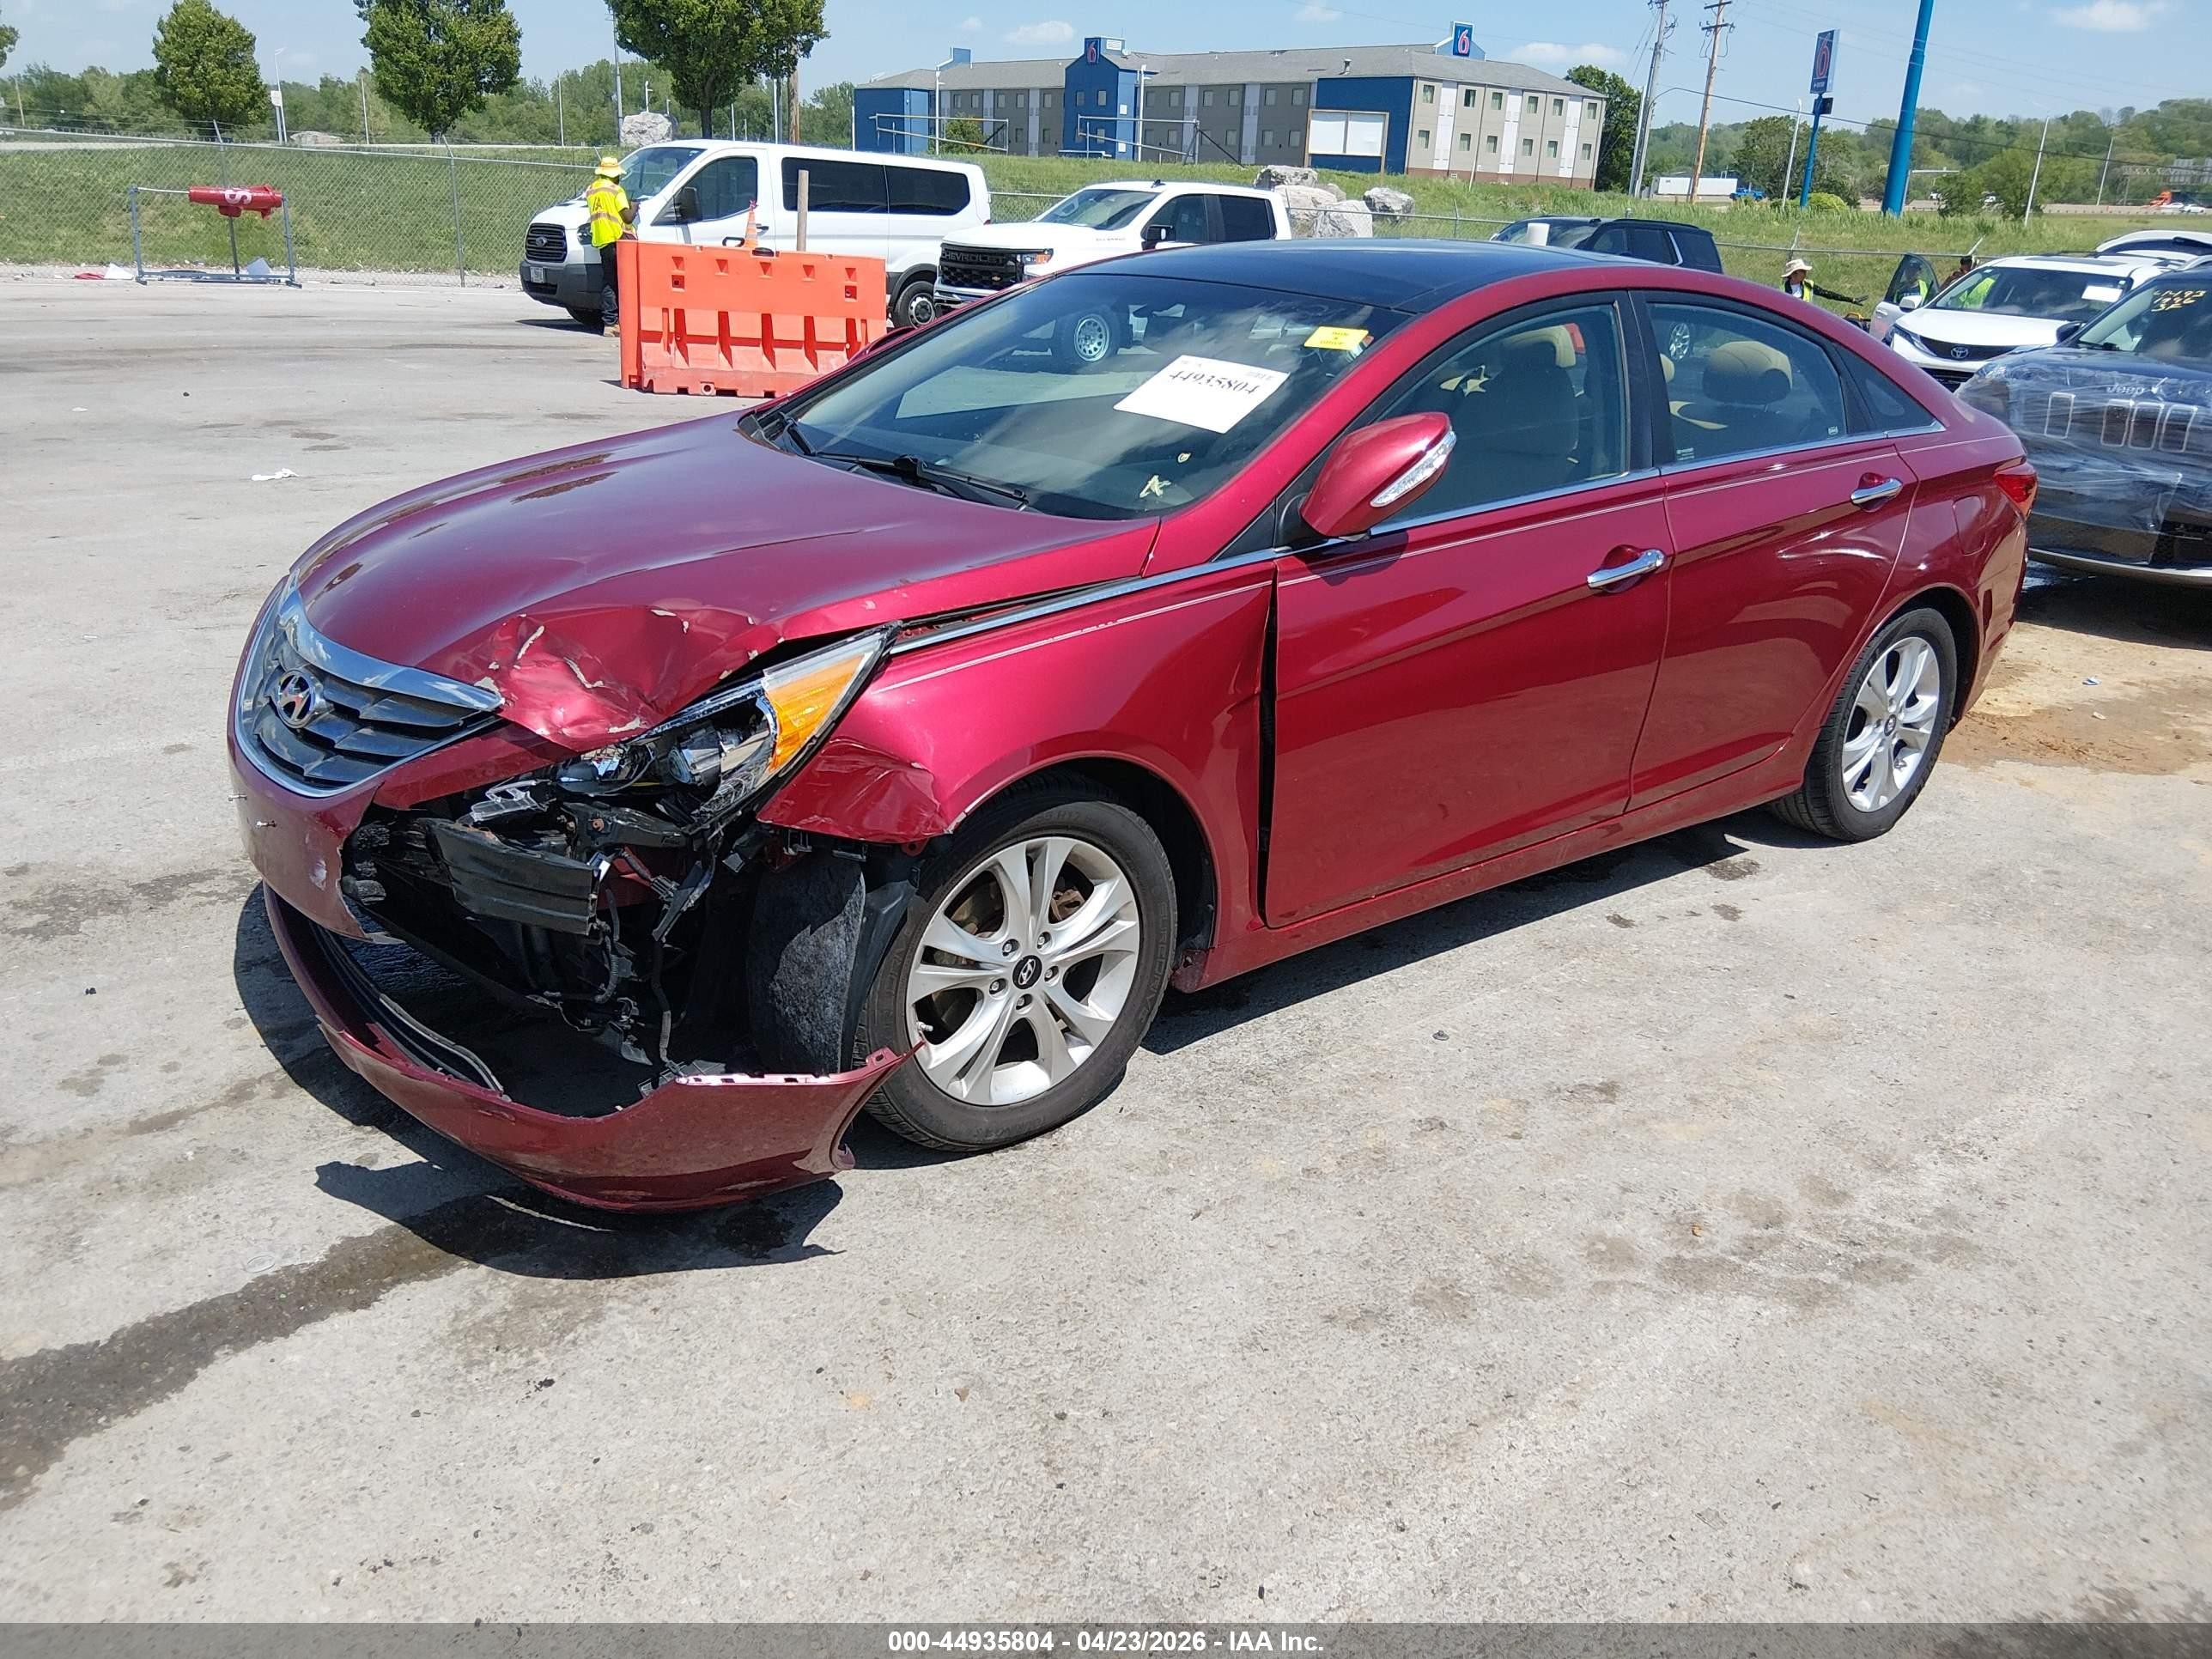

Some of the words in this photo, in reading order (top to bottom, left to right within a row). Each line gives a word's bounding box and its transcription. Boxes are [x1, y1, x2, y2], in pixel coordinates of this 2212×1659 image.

[1086, 41, 1097, 63] 6
[1457, 29, 1470, 54] 6
[1816, 33, 1830, 78] 6
[2106, 383, 2145, 398] Jeep
